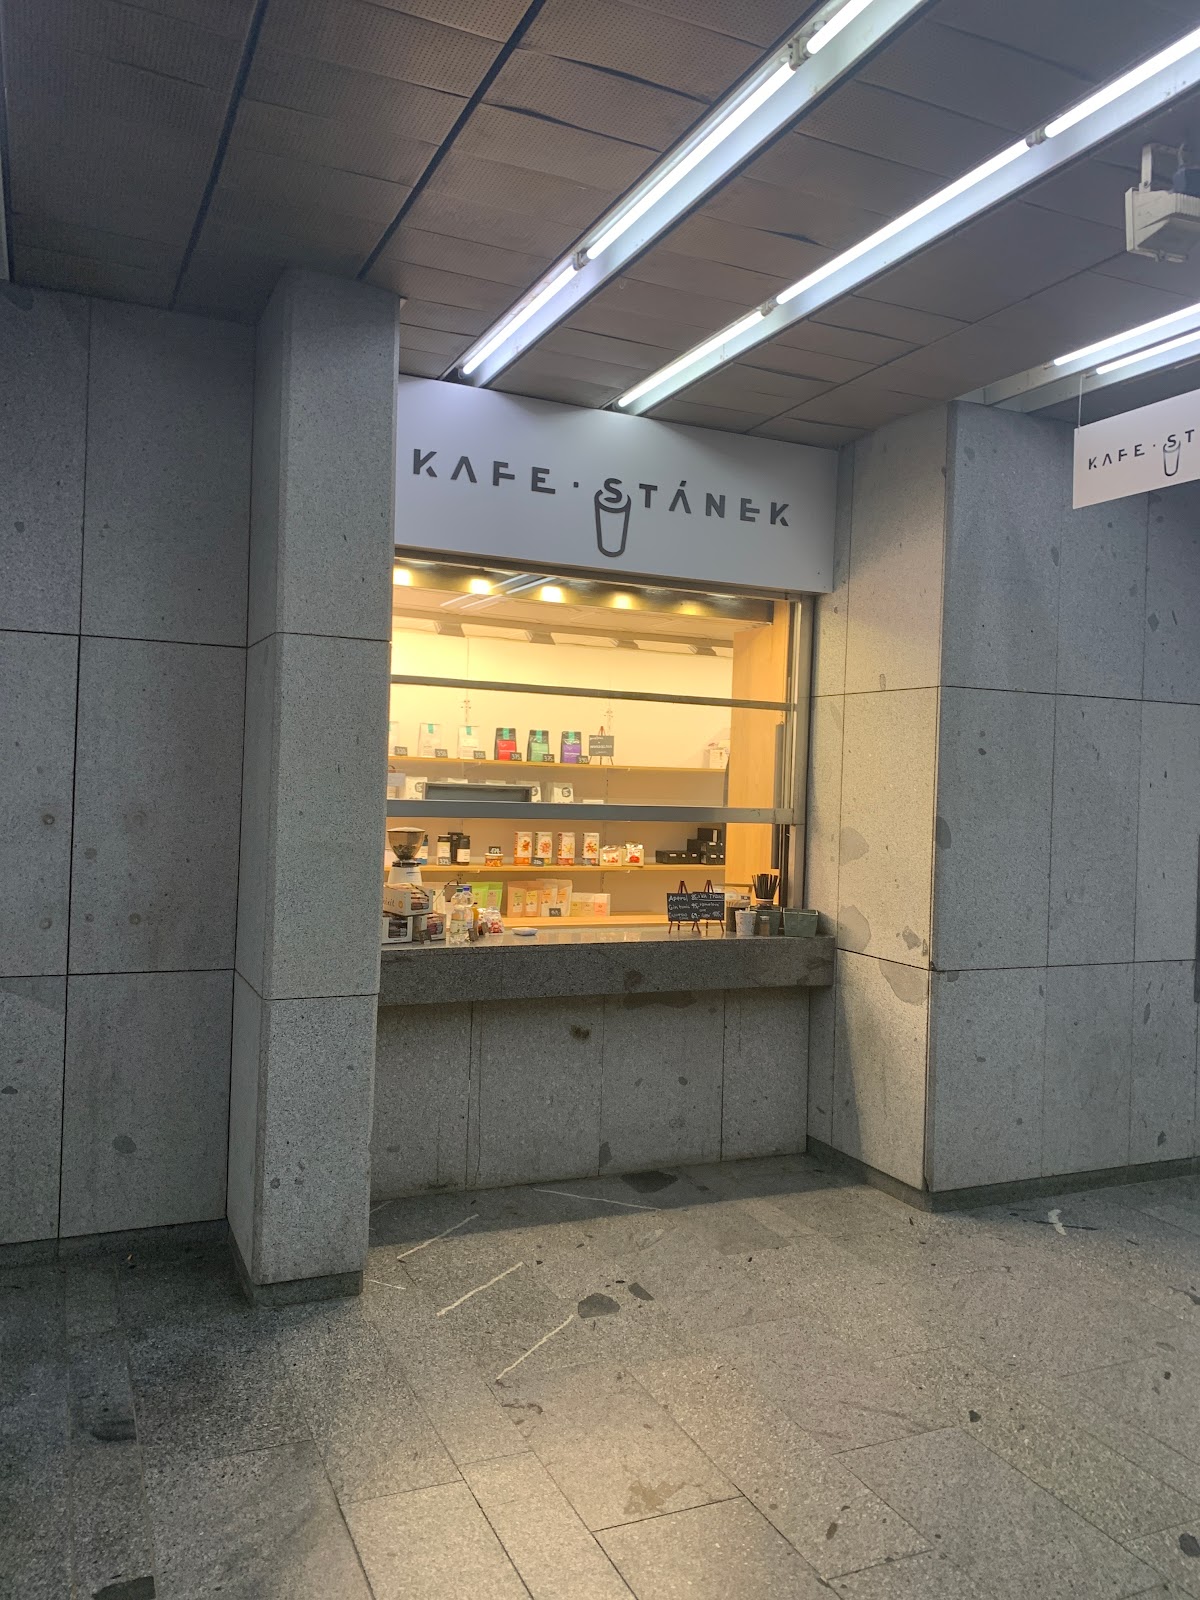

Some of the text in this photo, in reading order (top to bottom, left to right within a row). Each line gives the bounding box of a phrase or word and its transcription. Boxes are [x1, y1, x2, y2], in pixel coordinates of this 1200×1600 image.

[1088, 443, 1146, 471] KAFE
[412, 448, 790, 527] KAFE STÁNEK
